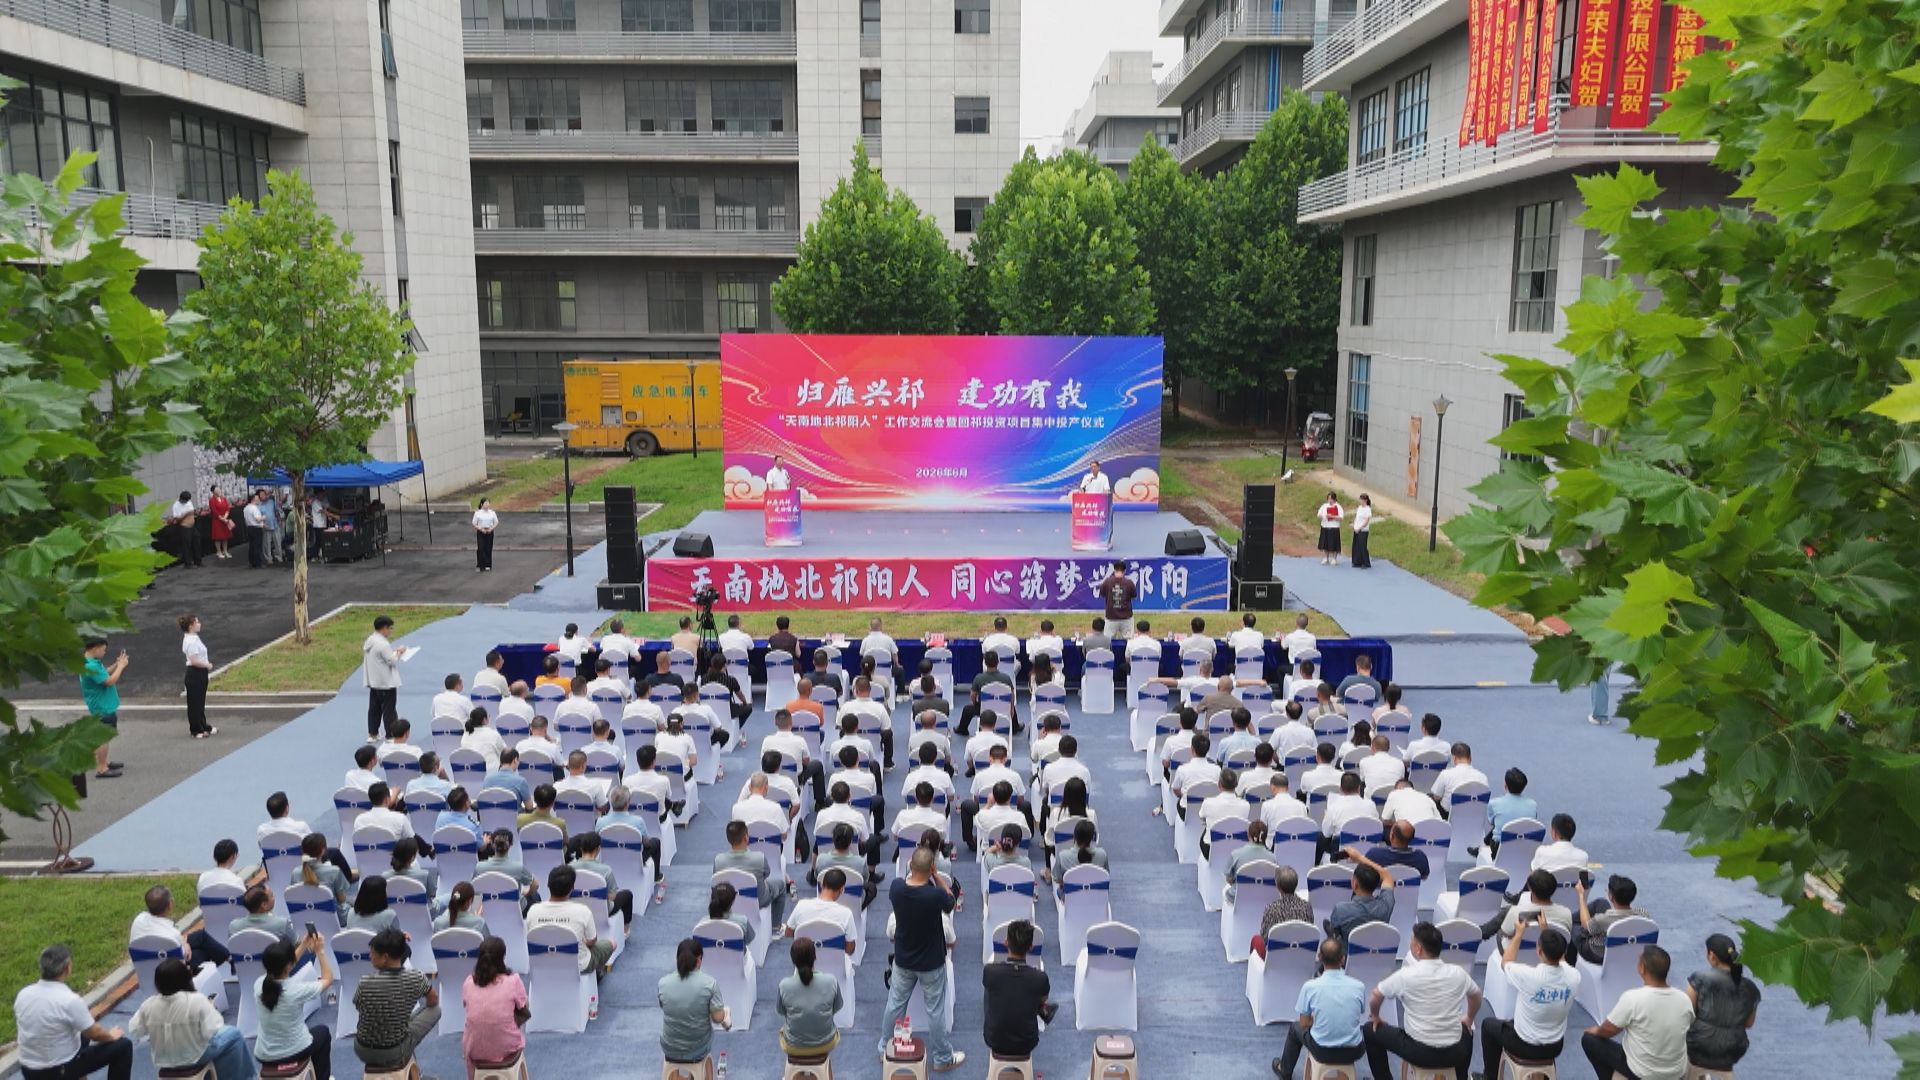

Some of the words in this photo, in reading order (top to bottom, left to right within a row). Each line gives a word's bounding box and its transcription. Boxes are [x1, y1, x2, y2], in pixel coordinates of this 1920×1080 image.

[797, 376, 925, 410] 归雁兴祁
[957, 376, 1087, 409] 建功有我
